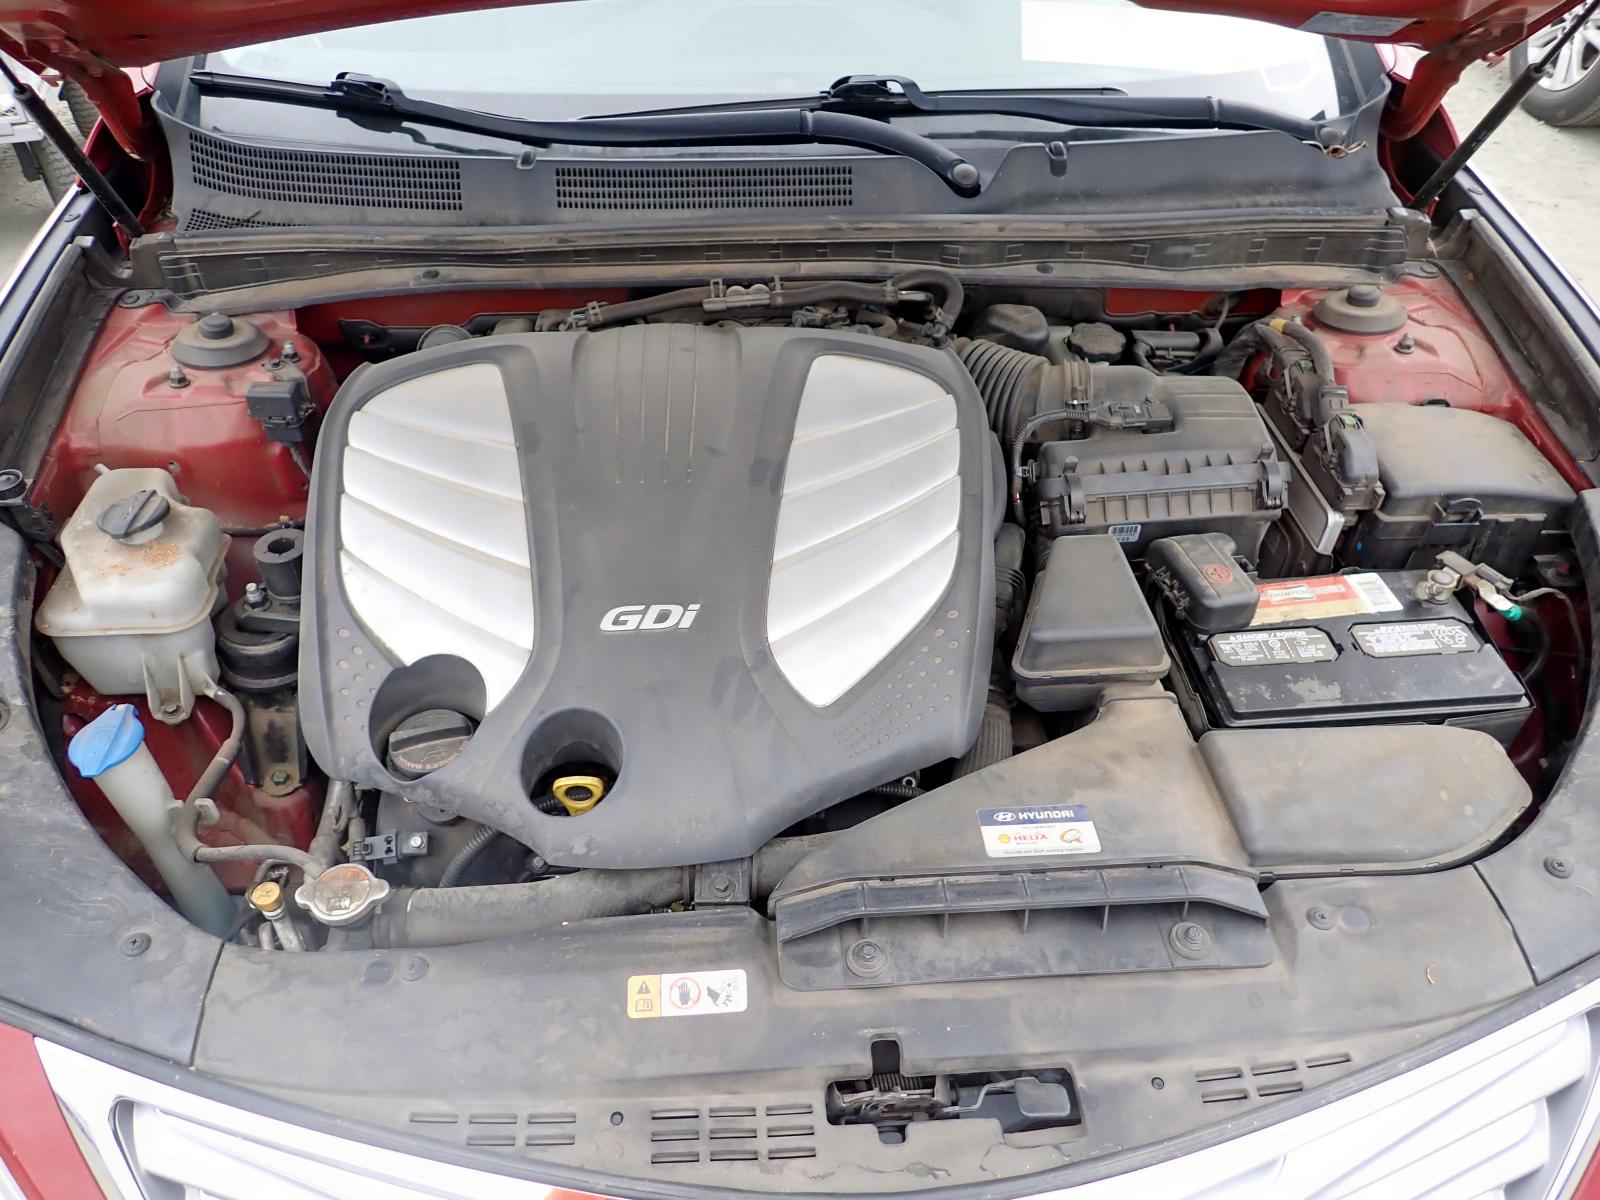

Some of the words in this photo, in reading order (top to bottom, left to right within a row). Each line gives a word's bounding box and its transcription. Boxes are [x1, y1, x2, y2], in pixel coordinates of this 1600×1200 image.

[600, 604, 701, 631] GDi
[1018, 809, 1075, 821] HYUNDAI
[1013, 832, 1048, 842] HELIX
